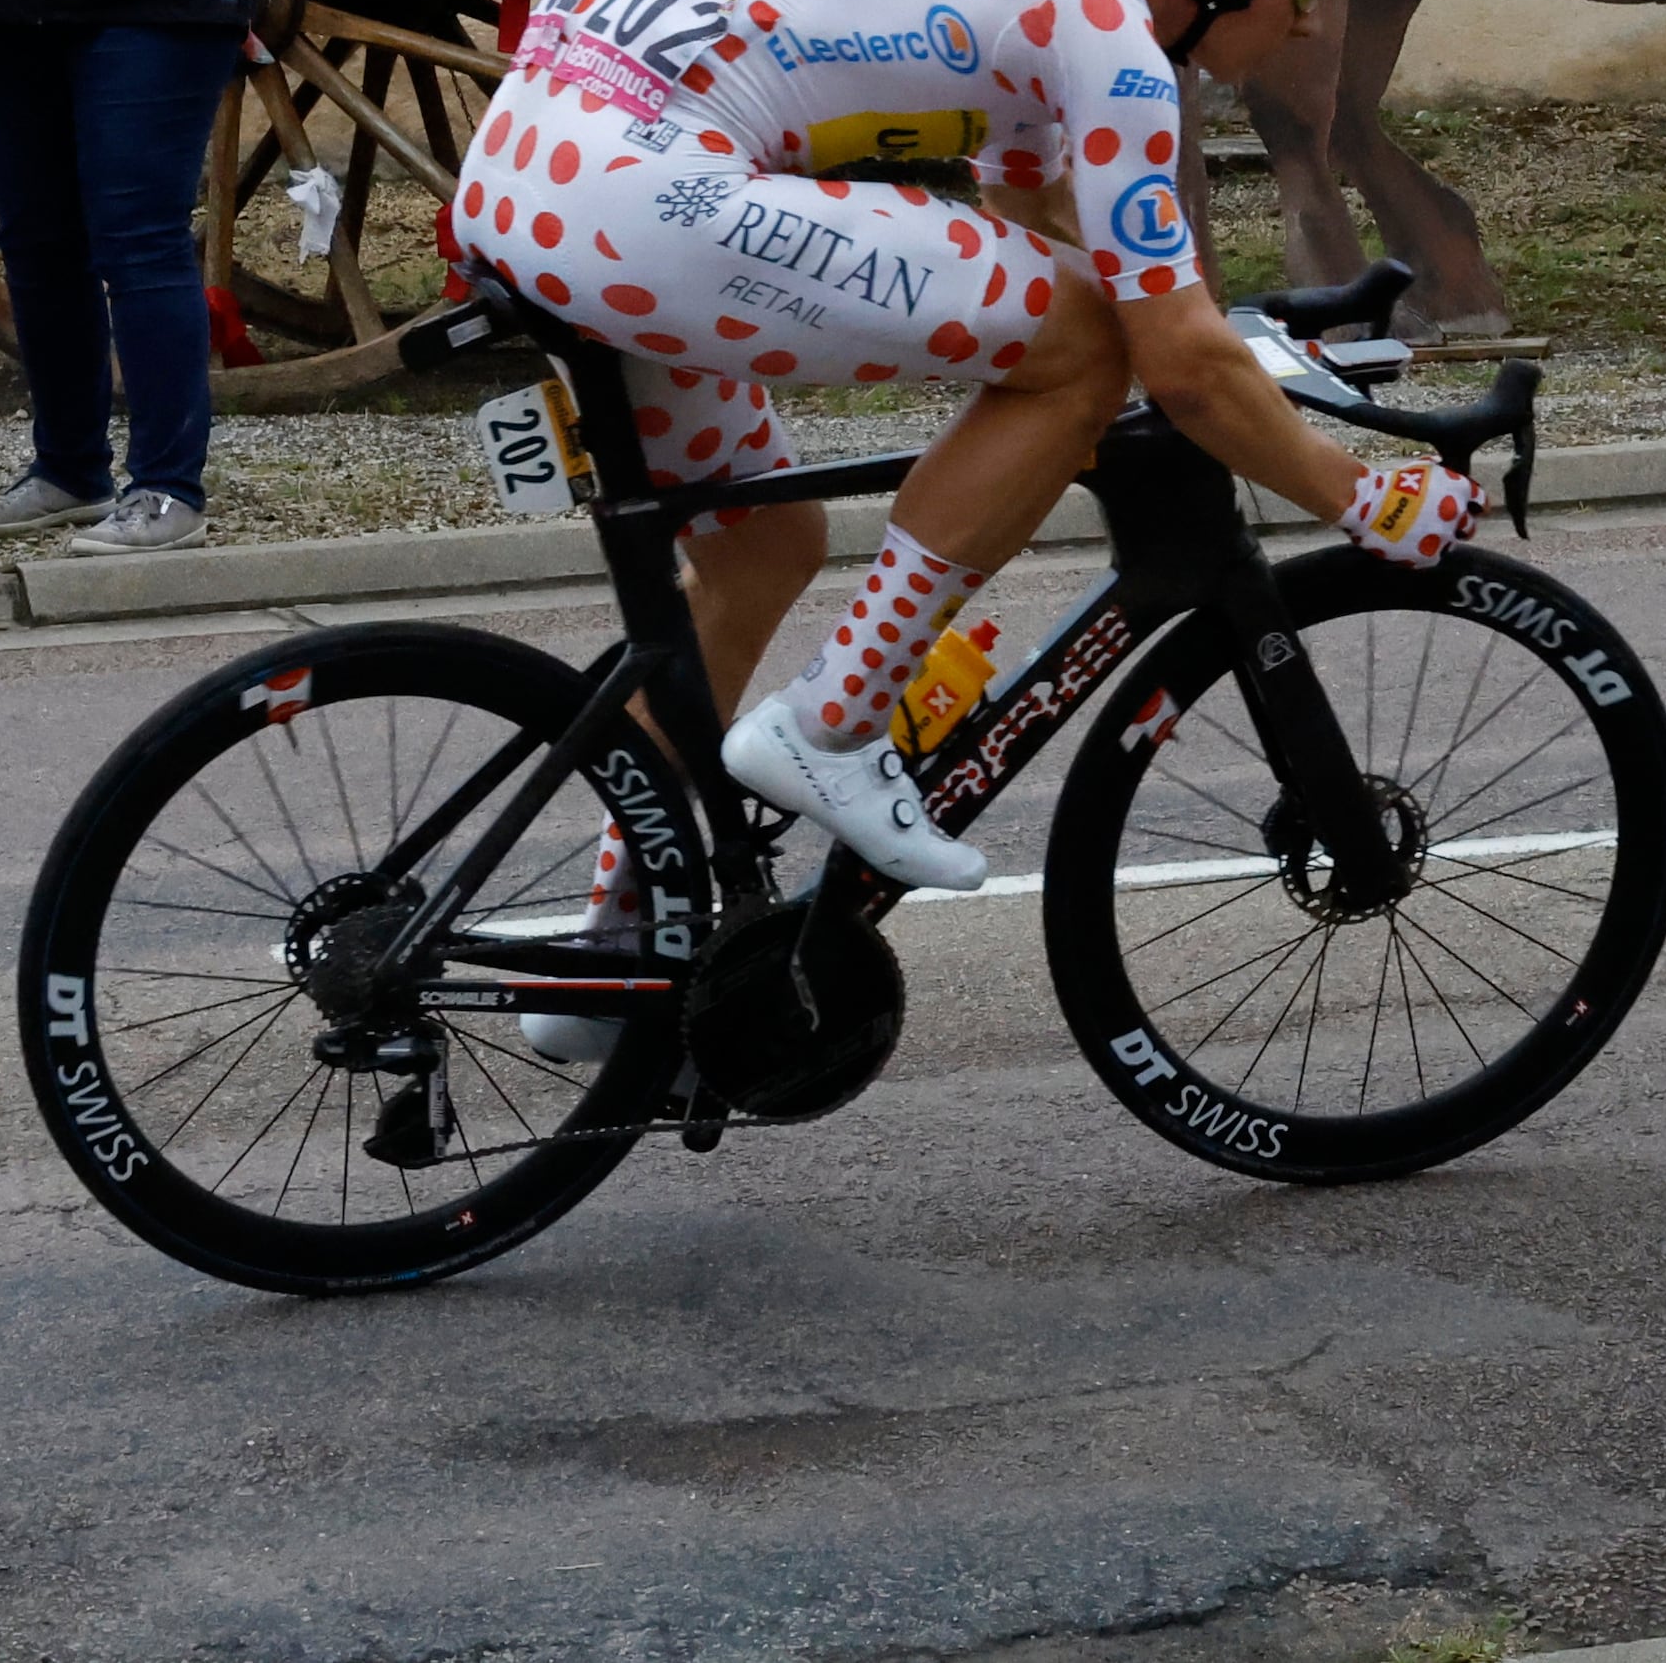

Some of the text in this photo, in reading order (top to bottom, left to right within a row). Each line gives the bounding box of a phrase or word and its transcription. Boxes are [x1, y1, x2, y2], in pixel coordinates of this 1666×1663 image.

[563, 33, 667, 110] lastminute
[716, 201, 934, 317] REITAN
[719, 275, 828, 330] RETAIL
[489, 408, 556, 495] 202
[1380, 497, 1410, 532] Uno
[1450, 575, 1633, 707] DT SWISS
[591, 749, 692, 962] DT SWISS
[47, 973, 150, 1182] DT SWISS
[1109, 1027, 1290, 1159] DT SWISS
